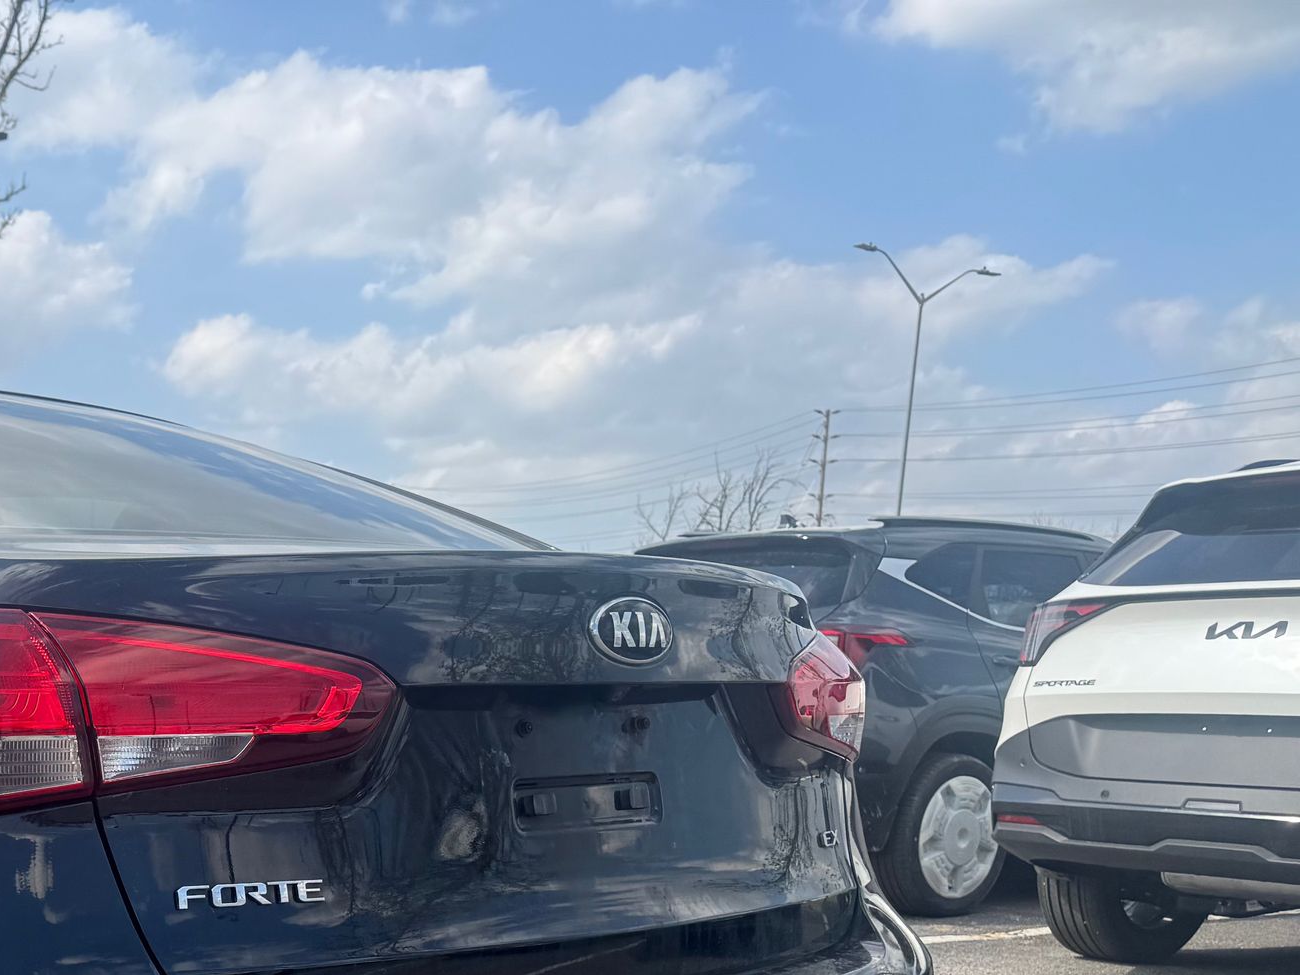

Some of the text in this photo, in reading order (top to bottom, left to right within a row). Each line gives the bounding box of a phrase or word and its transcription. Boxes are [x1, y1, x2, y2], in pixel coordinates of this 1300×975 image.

[609, 611, 667, 648] KIA
[1205, 620, 1289, 640] KIA
[1033, 679, 1097, 687] SPORTAGE
[176, 879, 325, 910] FORTE
